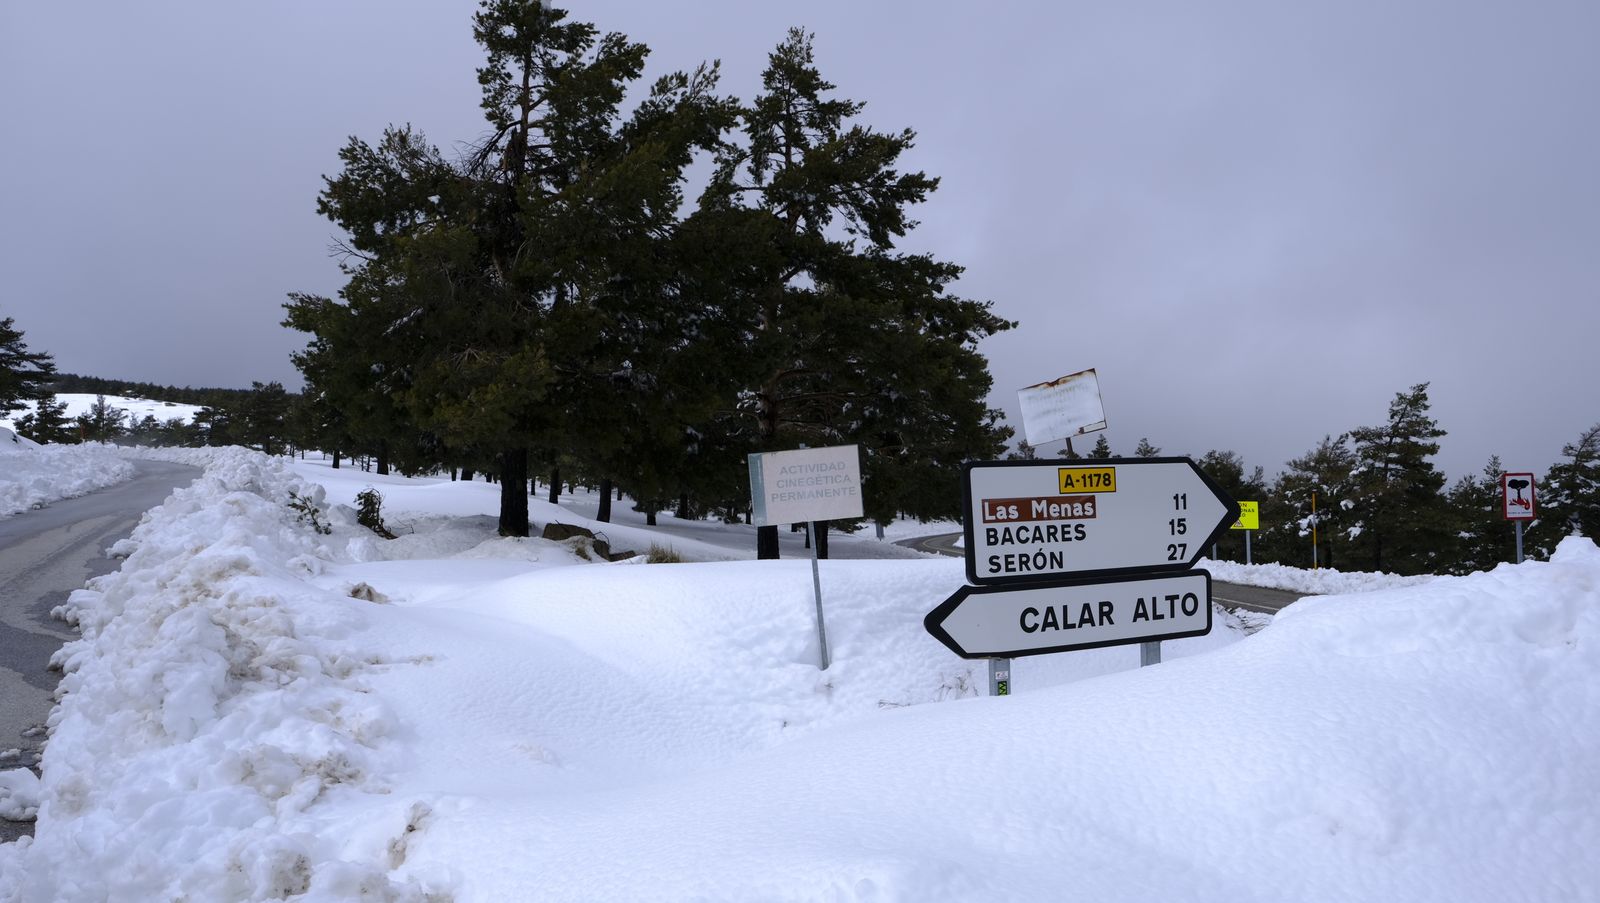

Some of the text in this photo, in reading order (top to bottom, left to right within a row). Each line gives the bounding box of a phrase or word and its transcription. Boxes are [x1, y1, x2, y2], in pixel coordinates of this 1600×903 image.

[780, 462, 846, 474] ACTIVIDAD
[776, 474, 852, 488] CINEGÉTICA
[1064, 473, 1111, 488] A-1178
[771, 487, 856, 502] PERMANENTE
[984, 493, 1187, 520] Las Menas 11
[986, 518, 1187, 546] BACARES 15
[988, 543, 1187, 573] SERÓN 27
[1020, 593, 1198, 633] CALAR ALTO
